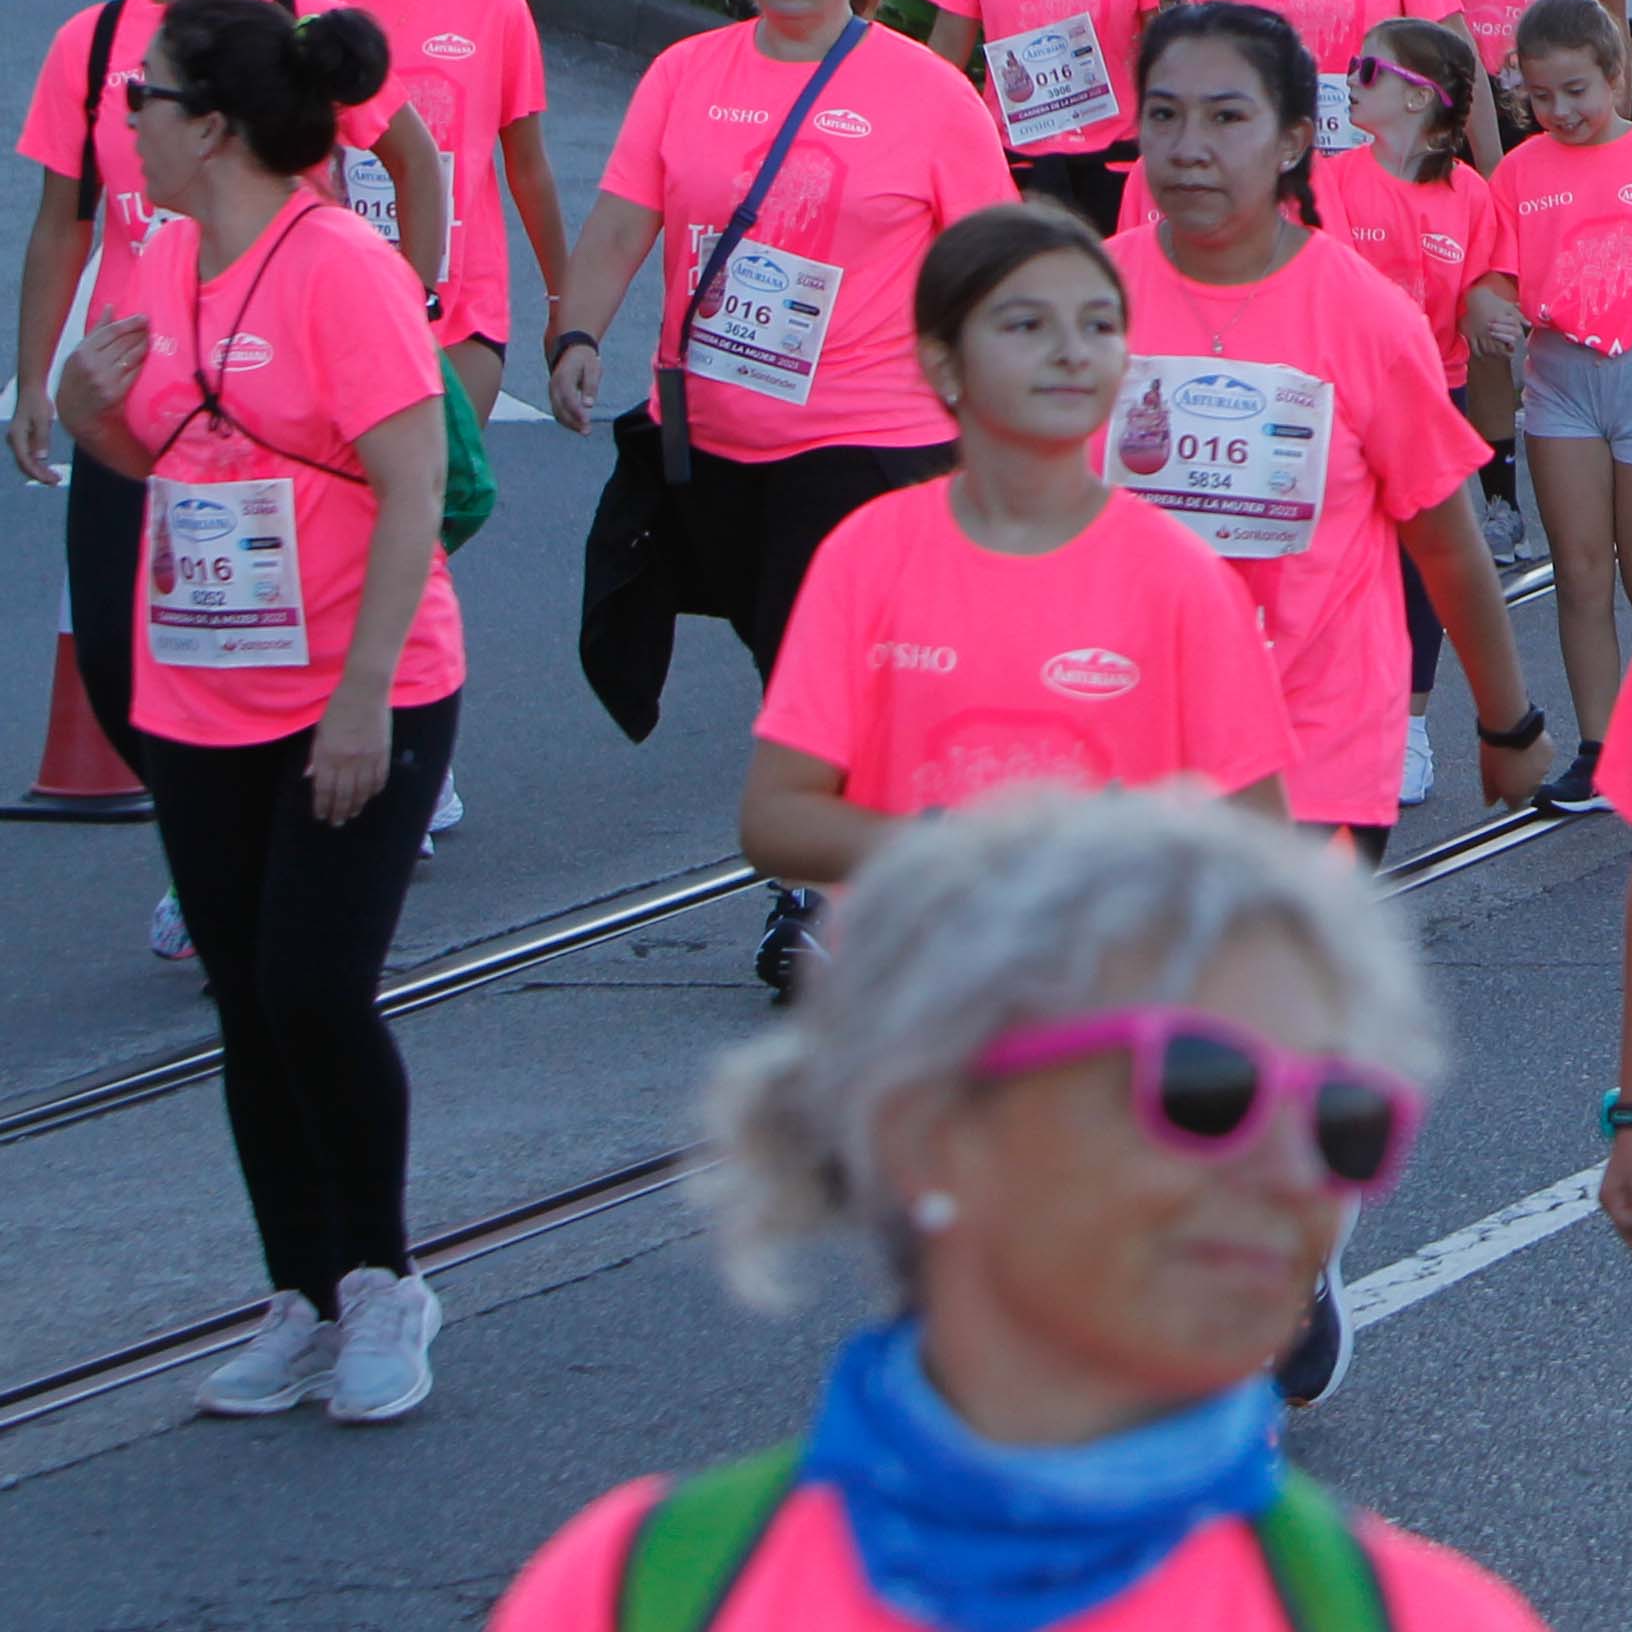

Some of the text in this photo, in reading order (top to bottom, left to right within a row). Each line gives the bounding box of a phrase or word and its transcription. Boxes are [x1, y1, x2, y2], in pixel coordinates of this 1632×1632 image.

[1472, 21, 1513, 36] NOSO
[1036, 64, 1073, 87] 016
[708, 105, 768, 125] OYSHO
[817, 116, 867, 134] ASTURIANA
[1317, 116, 1338, 131] 16
[355, 199, 396, 218] 016
[1519, 192, 1573, 215] OYSHO
[1352, 227, 1385, 241] SHO
[733, 261, 784, 289] ASTURIANA
[725, 295, 772, 325] 016
[725, 322, 756, 342] 3624
[719, 341, 734, 355] DE
[750, 368, 796, 391] Santander
[1182, 390, 1258, 411] ASTURIANA
[1177, 434, 1249, 464] 016
[1188, 470, 1233, 490] 5834
[1186, 496, 1202, 508] DE
[1203, 498, 1220, 509] LA
[1222, 499, 1265, 514] MUJER
[1233, 527, 1298, 543] Santander
[179, 556, 233, 583] 016
[1053, 664, 1132, 686] ASTURIANA
